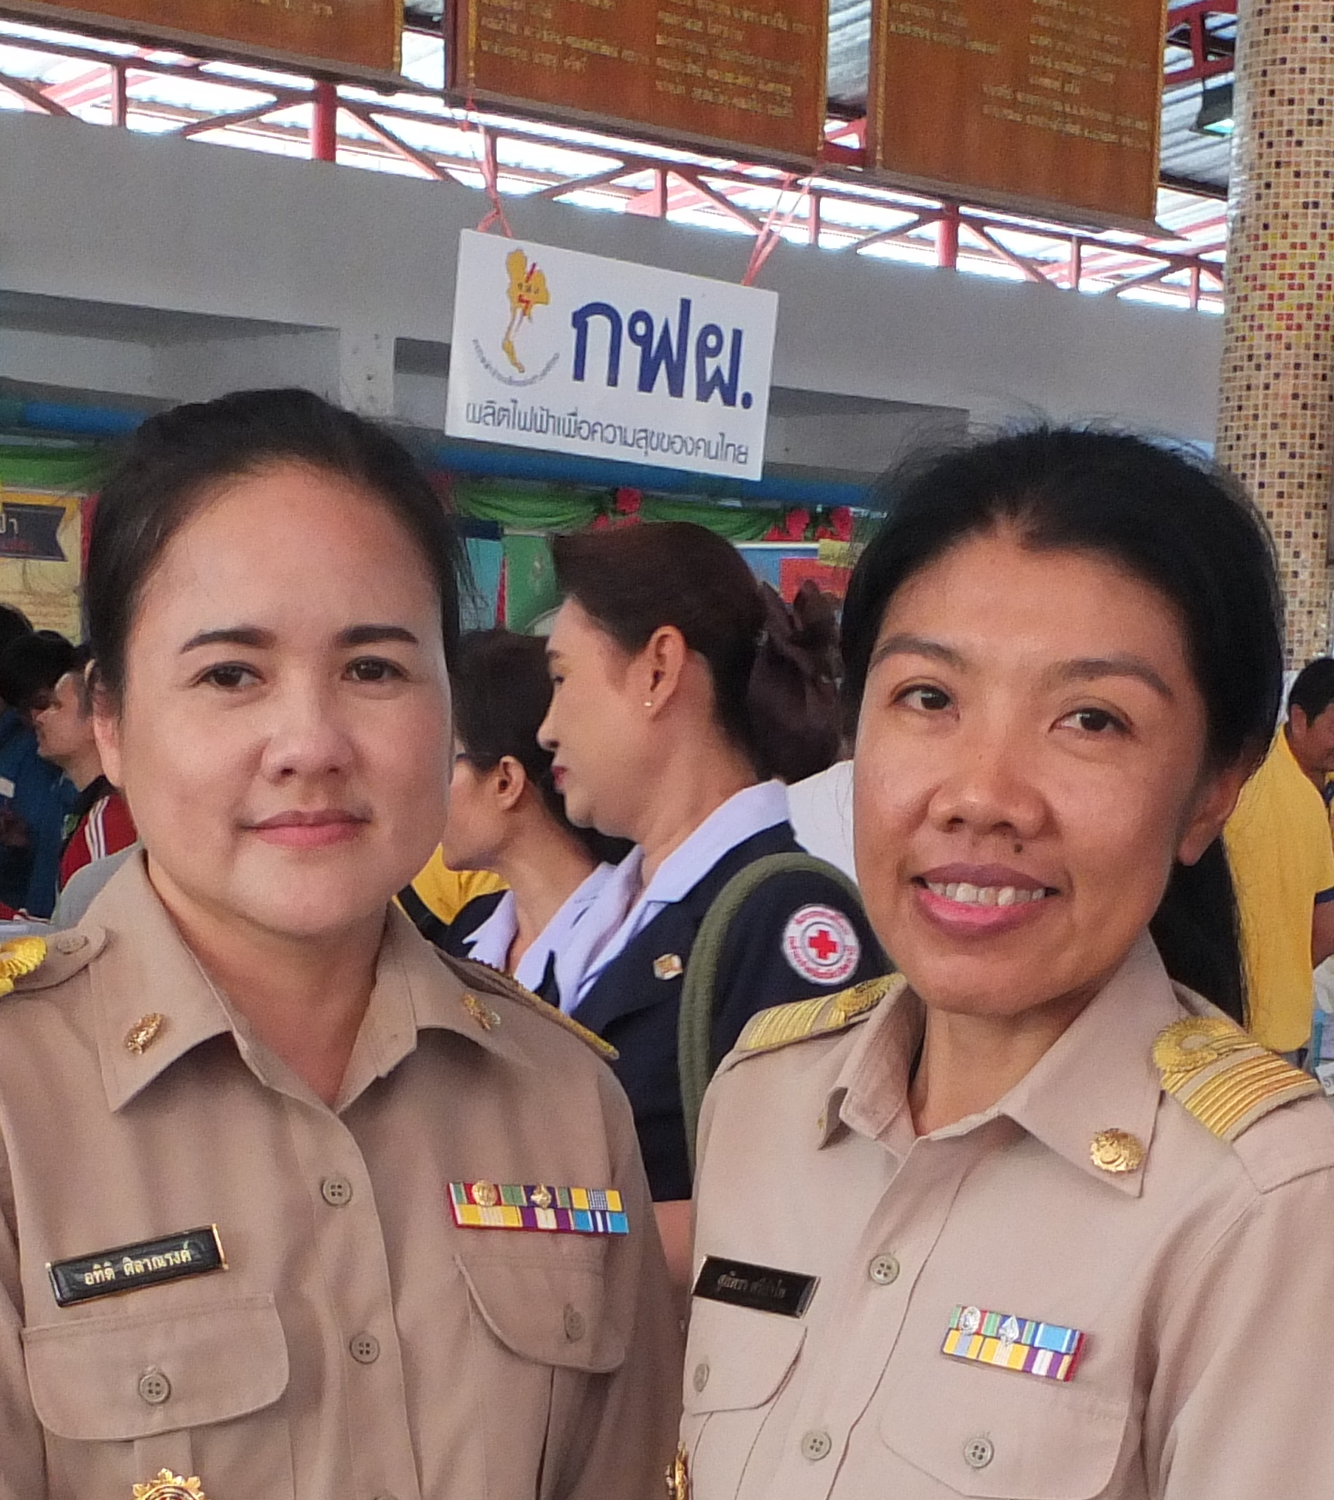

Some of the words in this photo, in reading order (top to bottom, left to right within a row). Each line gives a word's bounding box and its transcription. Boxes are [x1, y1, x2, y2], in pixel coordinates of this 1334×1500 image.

[570, 297, 754, 410] กฟผ.
[465, 399, 749, 466] ผลิตไฟฟ้าเพื่อความสุขของคนไทย
